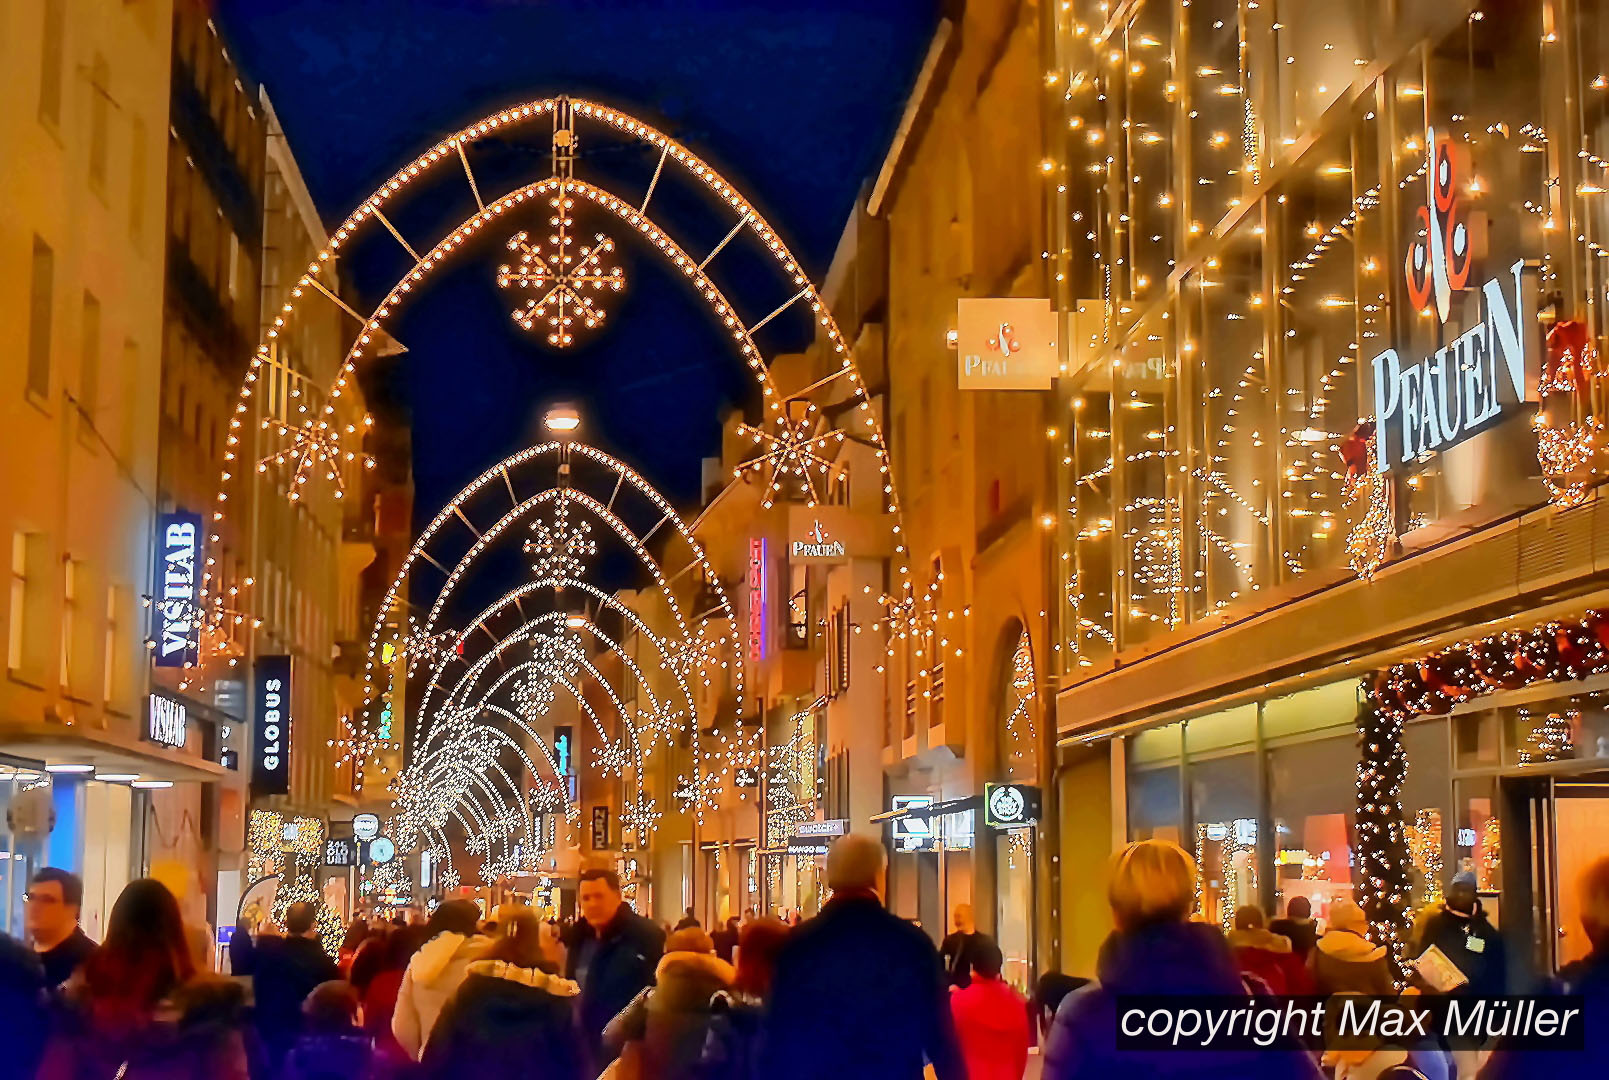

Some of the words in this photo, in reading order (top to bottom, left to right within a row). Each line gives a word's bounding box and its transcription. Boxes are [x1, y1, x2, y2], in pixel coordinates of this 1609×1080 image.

[1371, 258, 1525, 475] PFAUEN
[793, 541, 845, 557] PFAUEN
[263, 678, 282, 771] GLOBUS
